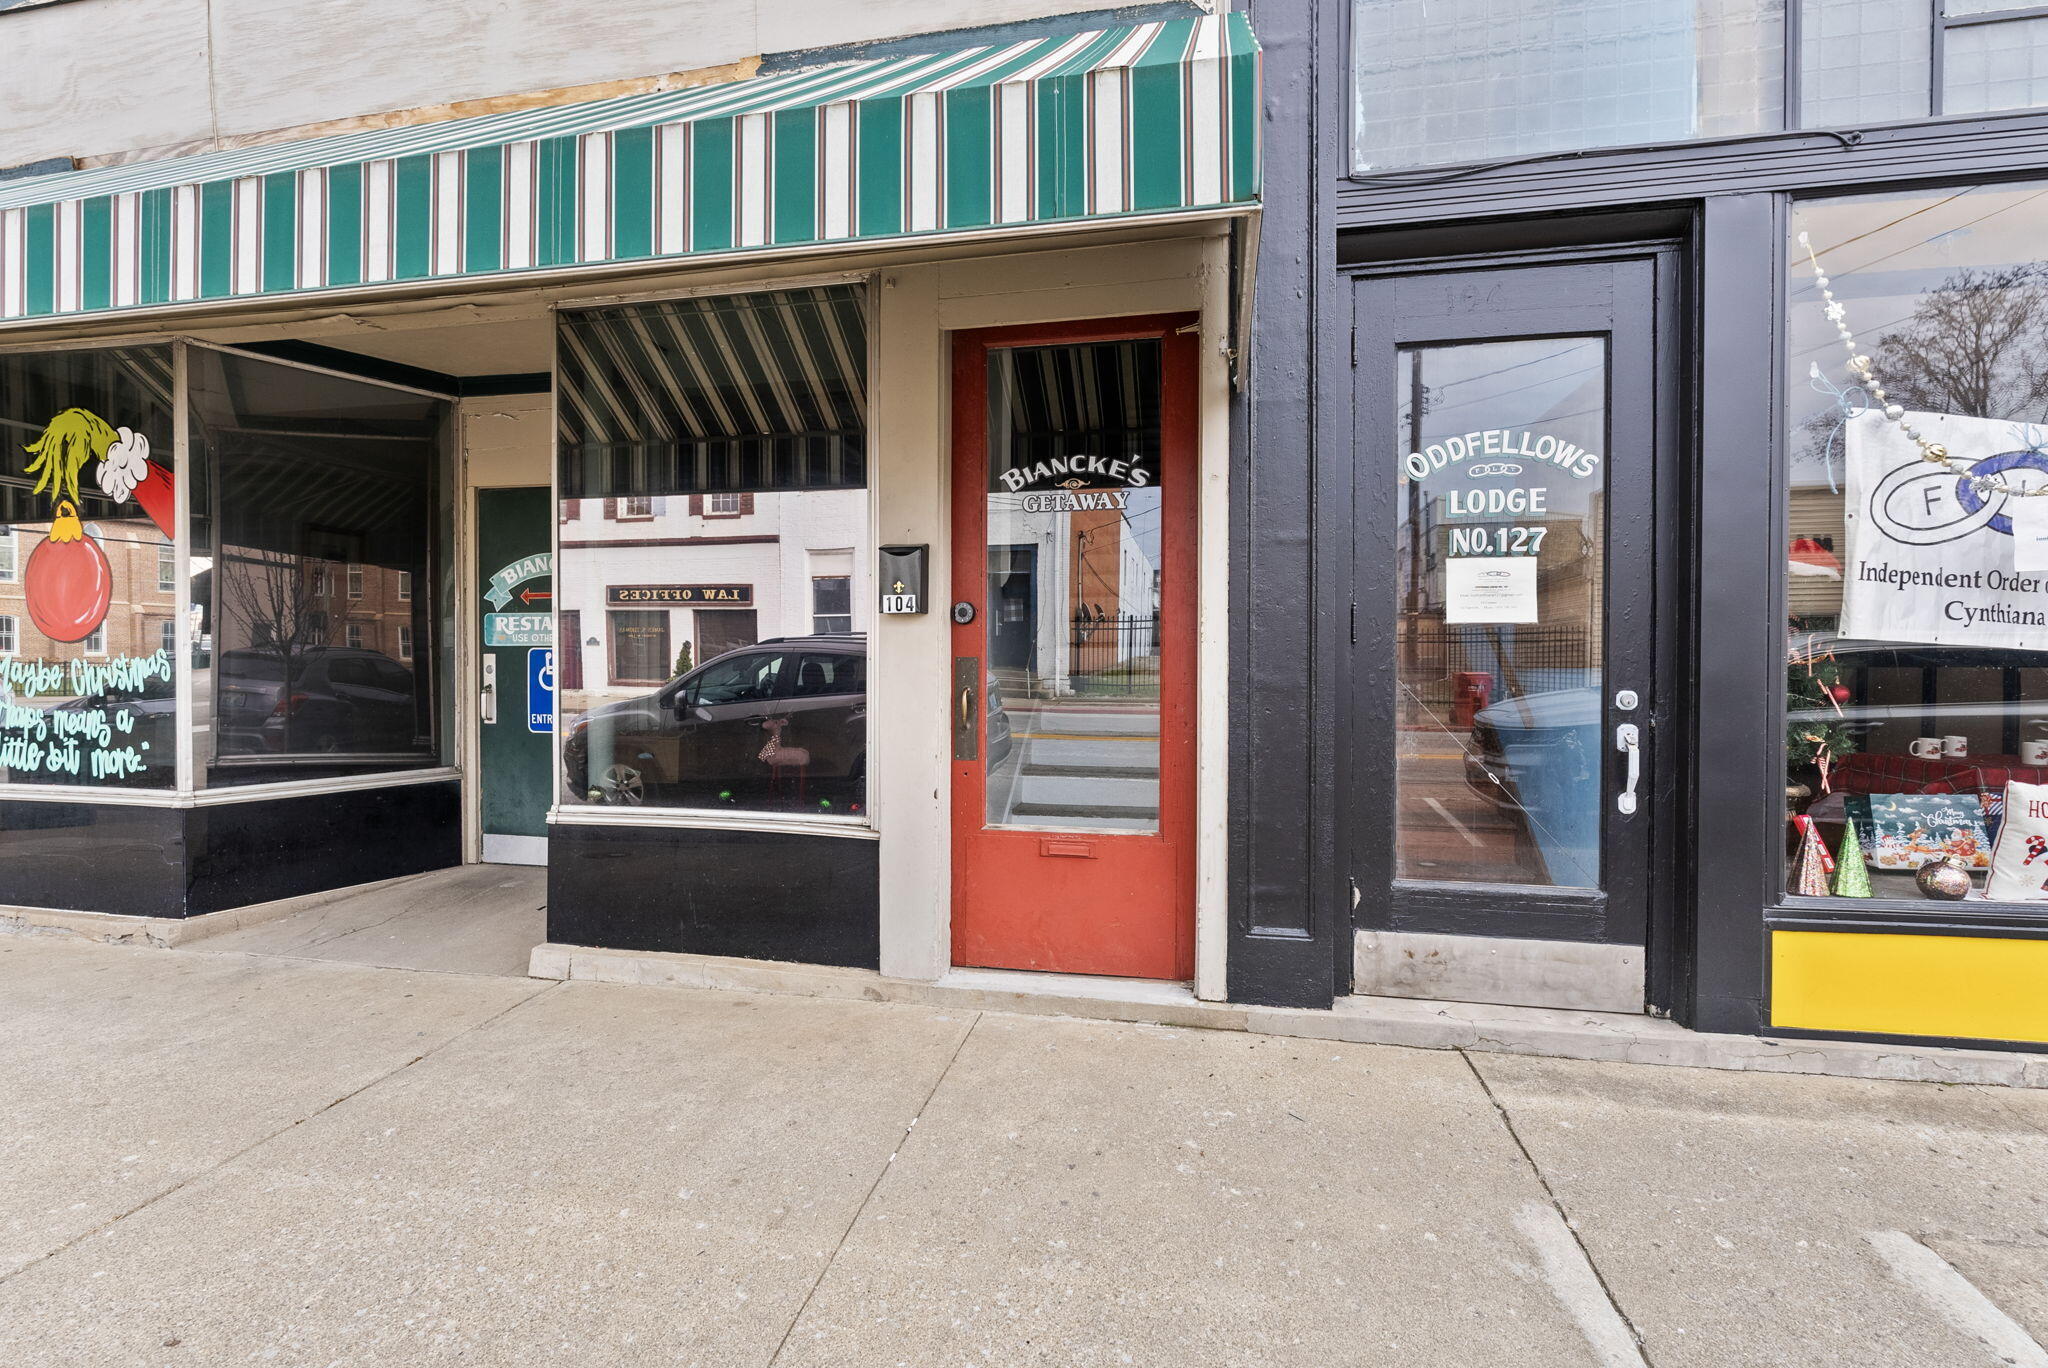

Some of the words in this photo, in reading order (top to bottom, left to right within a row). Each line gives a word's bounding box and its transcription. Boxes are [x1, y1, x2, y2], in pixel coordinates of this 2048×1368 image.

[1405, 430, 1600, 480] ODDFELLOWS
[1022, 491, 1131, 513] GETAWAY
[1446, 487, 1547, 516] LODGE
[1923, 485, 1942, 516] F
[501, 556, 552, 586] BIAN
[1859, 560, 1983, 591] Independent
[1987, 569, 2041, 593] Order
[886, 596, 914, 612] 104
[1944, 600, 2046, 628] Cynthiana
[512, 633, 529, 642] USE
[70, 648, 171, 697] Christmas
[53, 709, 111, 748] means
[116, 708, 134, 734] a
[531, 714, 553, 724] ENTR
[46, 737, 80, 775] bit
[1920, 810, 1980, 828] Christmas
